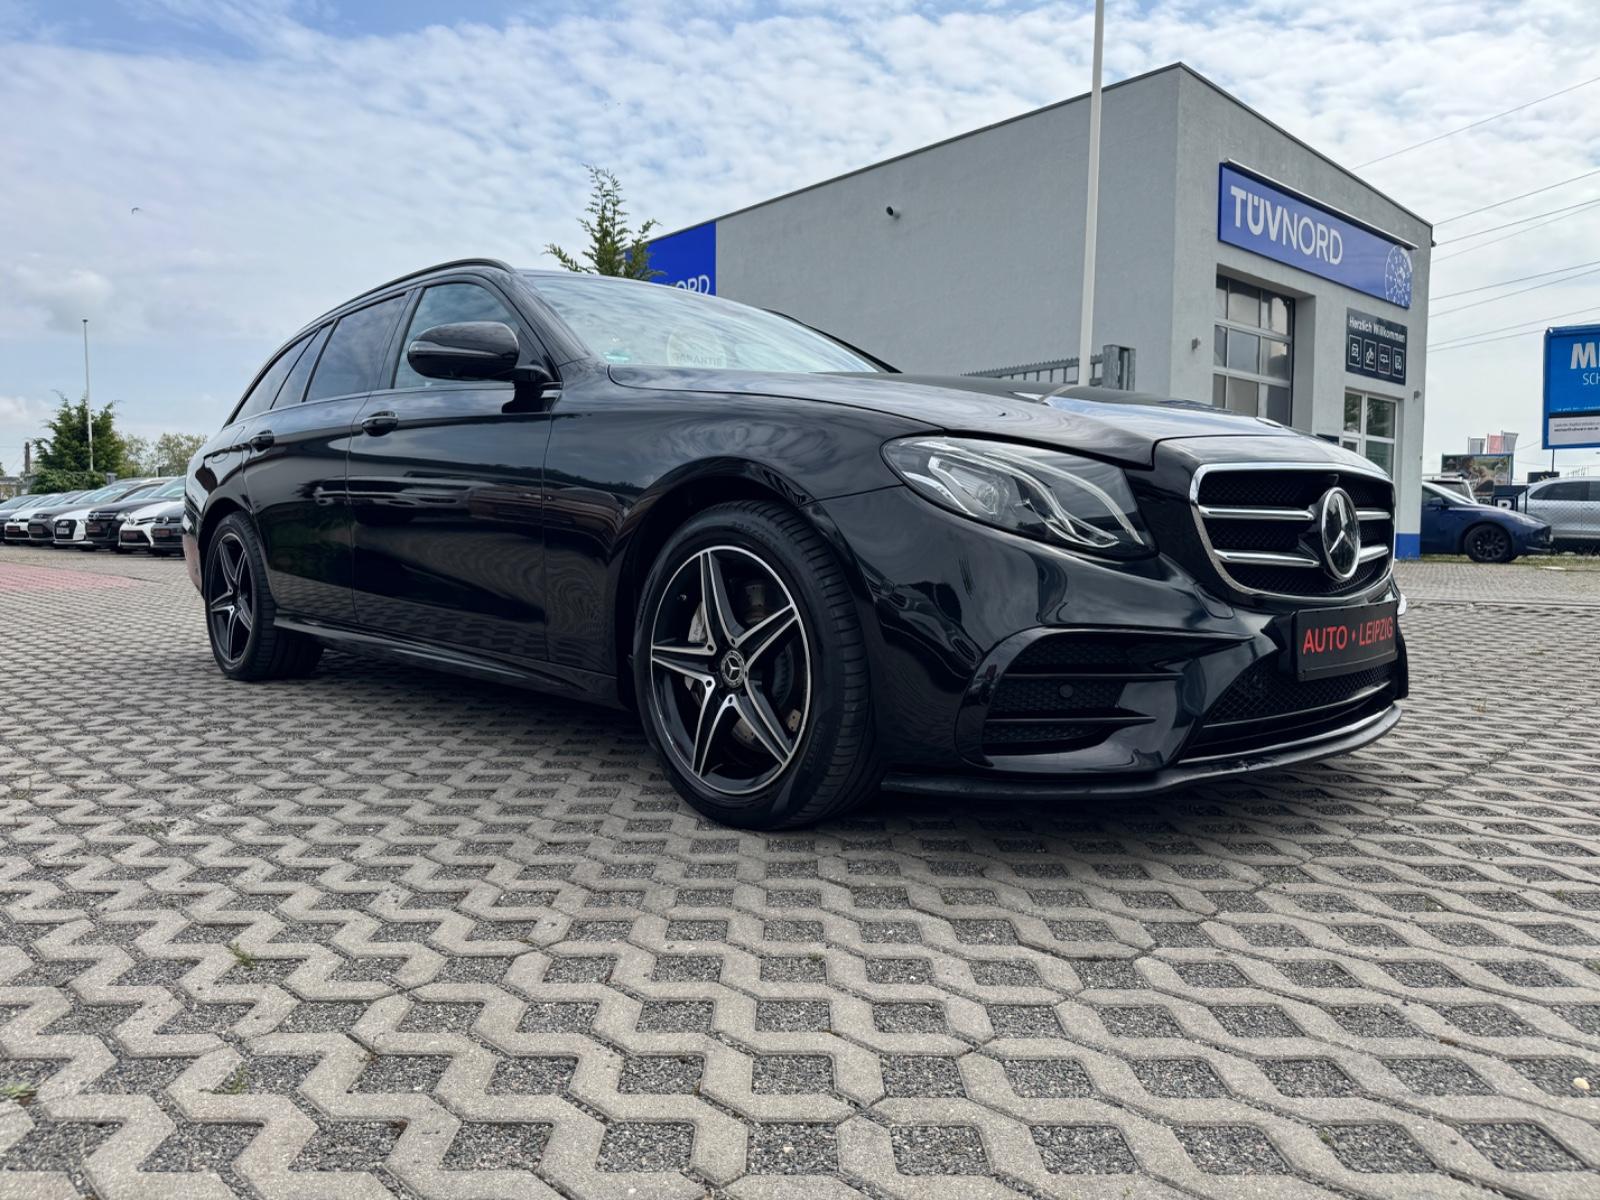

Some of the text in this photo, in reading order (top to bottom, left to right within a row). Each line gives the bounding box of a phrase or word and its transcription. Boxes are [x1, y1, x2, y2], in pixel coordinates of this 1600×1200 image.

[1349, 315, 1405, 343] Herzlich Willkommen
[1570, 342, 1600, 369] M
[1303, 616, 1393, 655] AUTO LEIPZIG
